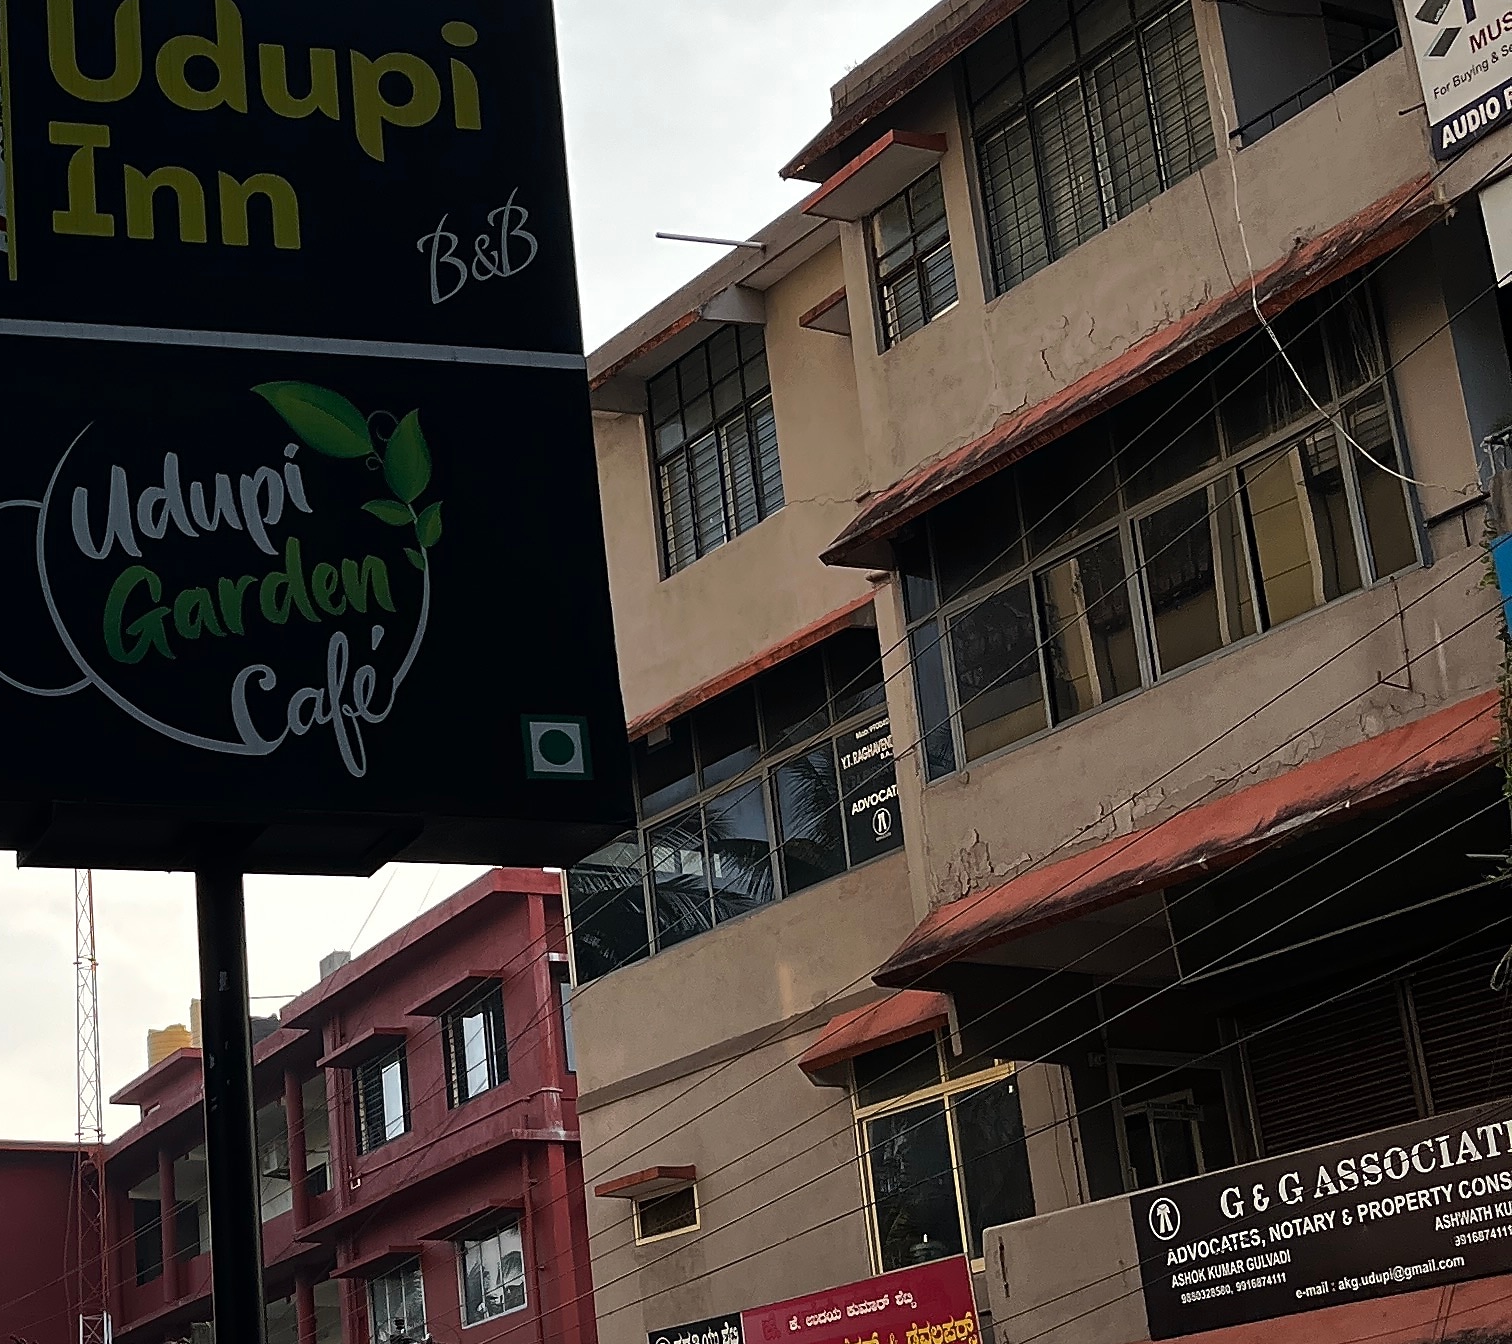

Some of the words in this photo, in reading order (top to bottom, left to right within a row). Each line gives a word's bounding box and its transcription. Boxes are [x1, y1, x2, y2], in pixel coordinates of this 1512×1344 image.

[1468, 10, 1512, 54] MUS
[1433, 82, 1451, 100] For
[1453, 61, 1489, 90] Buying
[1442, 95, 1503, 149] AUDIO
[48, 120, 301, 250] Inn
[416, 186, 539, 305] B&B
[72, 443, 312, 559] Udupi
[103, 536, 396, 664] Garden
[231, 624, 398, 778] Café
[1167, 1228, 1266, 1267] ADVOCATES,
[1268, 1210, 1337, 1243] NOTARY
[1342, 1208, 1354, 1227] &
[1358, 1185, 1454, 1224] PROPERTY
[1459, 1171, 1512, 1199] CONS
[1220, 1186, 1244, 1219] G
[1253, 1183, 1270, 1212] &
[1278, 1172, 1304, 1205] G
[1171, 1266, 1206, 1289] ASHOK
[1207, 1259, 1244, 1281] KUMAR
[1246, 1249, 1291, 1274] GULVADI
[1435, 1205, 1493, 1232] ASHWATH
[1495, 1199, 1512, 1218] KU
[1296, 1280, 1329, 1300] e-mail
